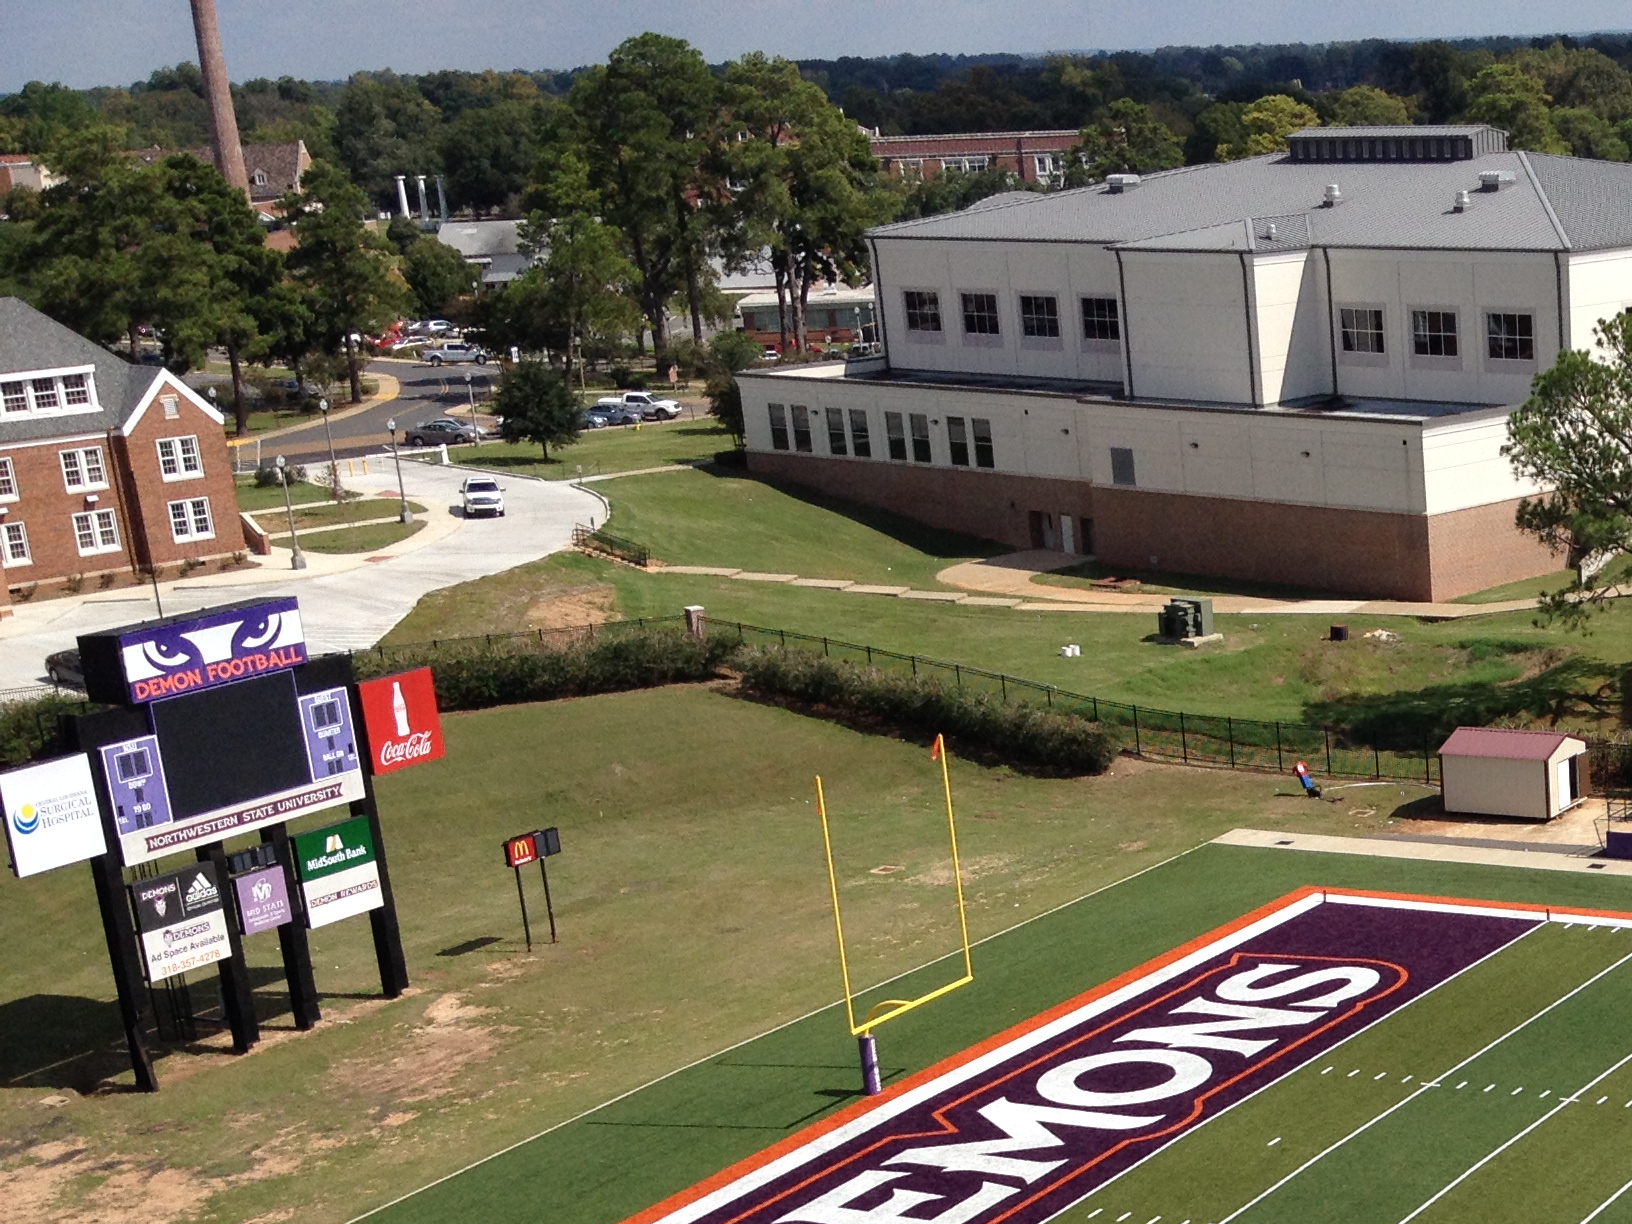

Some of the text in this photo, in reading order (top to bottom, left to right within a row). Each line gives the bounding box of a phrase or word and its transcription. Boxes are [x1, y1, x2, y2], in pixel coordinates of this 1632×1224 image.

[134, 647, 302, 699] DEMON FOOTBALL
[40, 797, 92, 816] SURGICAL
[149, 786, 341, 849] NORTHWESTERN STATE UNIVERSITY
[42, 808, 94, 828] HOSPITAL
[307, 844, 366, 871] MidSouth Bank
[142, 883, 176, 900] DEMONS
[186, 886, 218, 902] adidas
[173, 922, 210, 941] DEMONS
[151, 934, 224, 962] Ad Space Available
[161, 950, 221, 975] 318-357-4278
